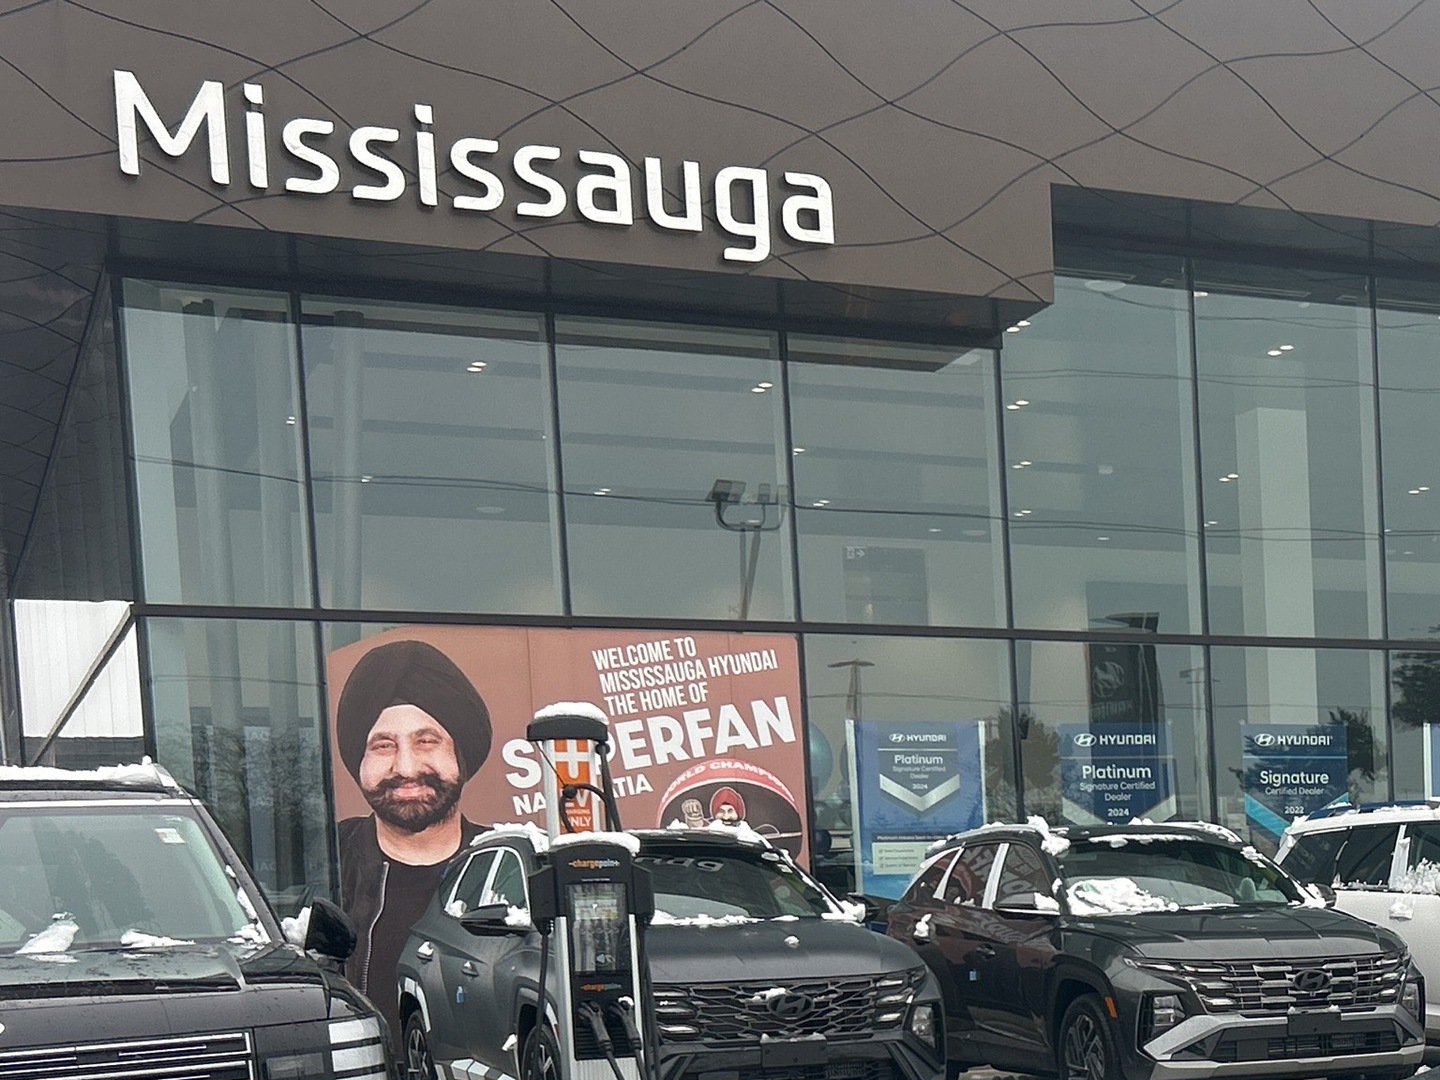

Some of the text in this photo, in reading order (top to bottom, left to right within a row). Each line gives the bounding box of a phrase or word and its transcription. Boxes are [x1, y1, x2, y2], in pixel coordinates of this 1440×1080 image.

[112, 68, 836, 264] Mississauga
[592, 636, 697, 671] WELCOME TO
[599, 649, 779, 694] MISSISSAUGA HYUNDAI
[604, 682, 709, 716] THE HOME OF
[502, 696, 797, 789] SPERFAN
[906, 734, 947, 742] HYUNDAI
[1099, 734, 1156, 745] HYUNDAI
[1277, 735, 1330, 745] HYUNDAI
[894, 754, 943, 764] Platinum
[1082, 764, 1151, 779] Platinum
[1260, 769, 1329, 787] Signature
[1079, 781, 1156, 792] Signature Certified
[1265, 787, 1324, 795] Certified Dealer
[1104, 792, 1131, 801] Dealer
[512, 792, 546, 816] NA
[1107, 808, 1129, 817] 2024
[1284, 806, 1305, 814] 2022
[561, 816, 592, 828] NLY
